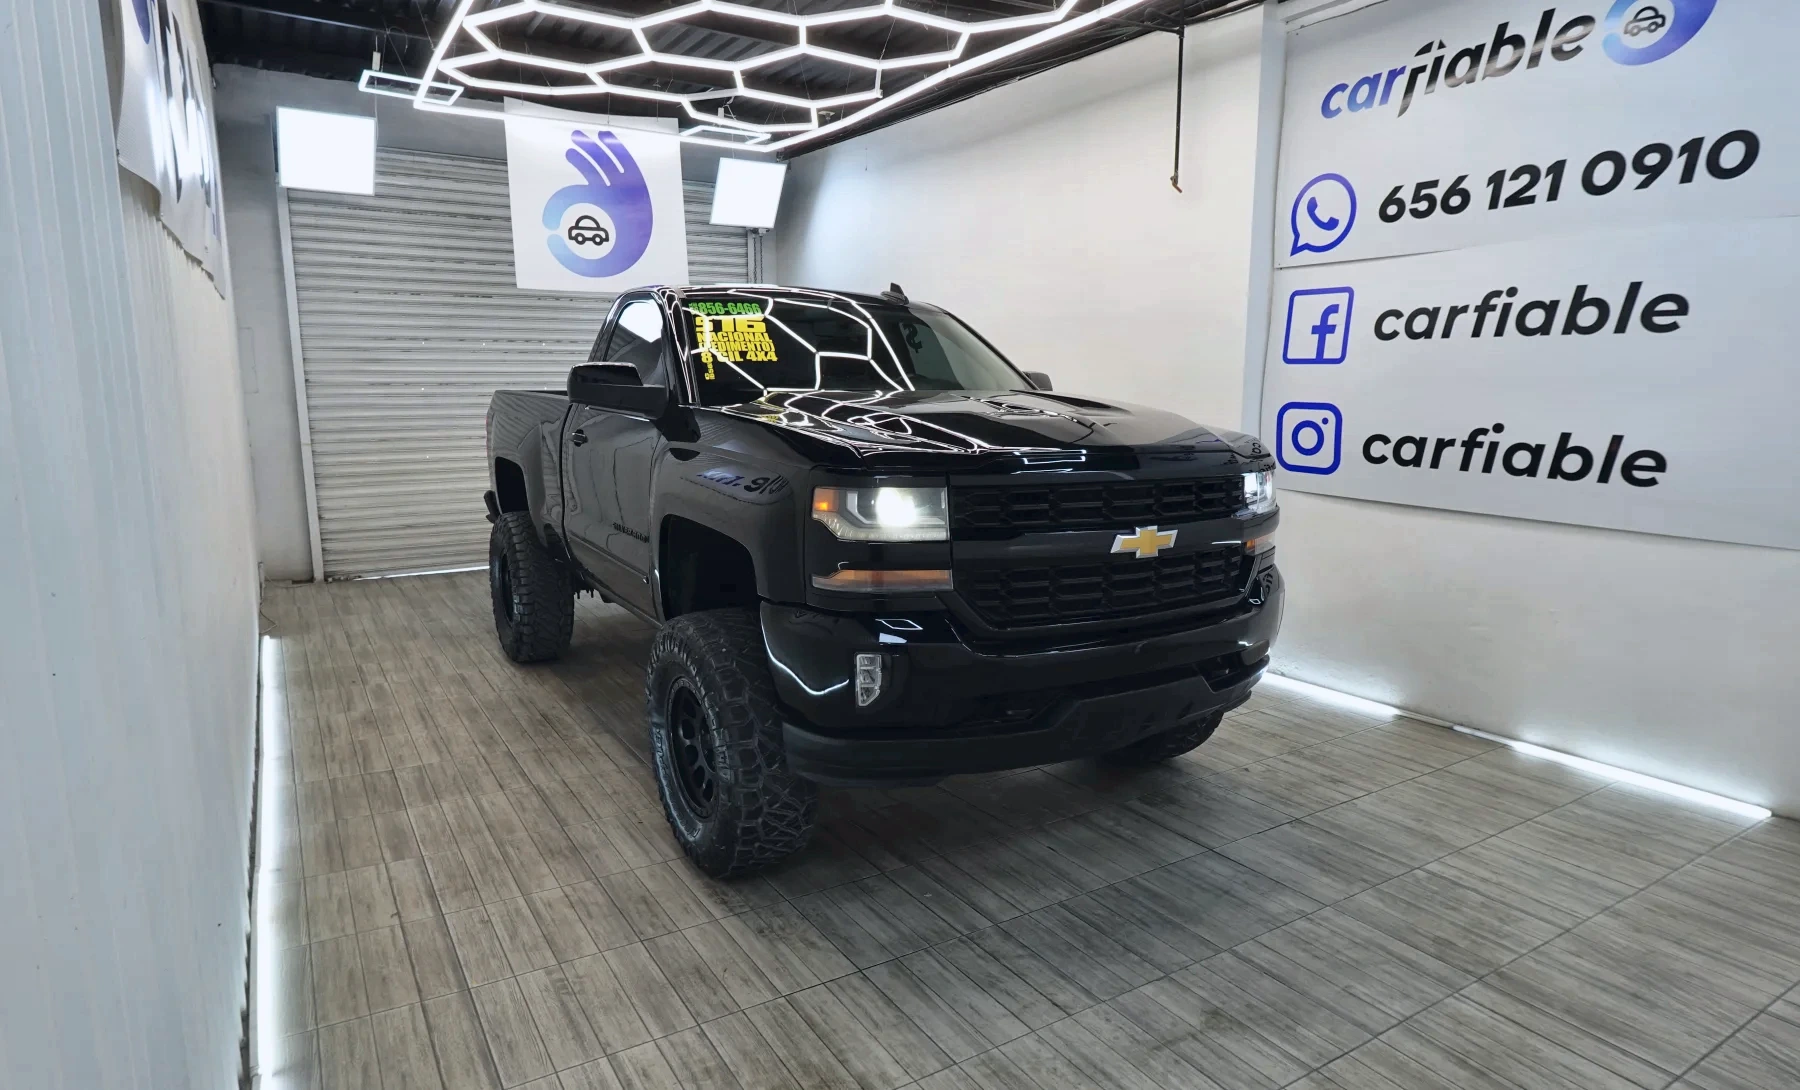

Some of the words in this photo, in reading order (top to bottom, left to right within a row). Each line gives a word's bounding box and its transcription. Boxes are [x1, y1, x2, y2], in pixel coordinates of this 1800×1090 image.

[1321, 7, 1596, 118] carfiable
[1378, 174, 1471, 224] 656
[1486, 158, 1567, 211] 121
[1581, 129, 1760, 197] 0910
[696, 332, 772, 342] NACIONAL
[1374, 281, 1690, 341] carfiable
[746, 351, 778, 362] 4X4
[1362, 422, 1668, 488] carfiable
